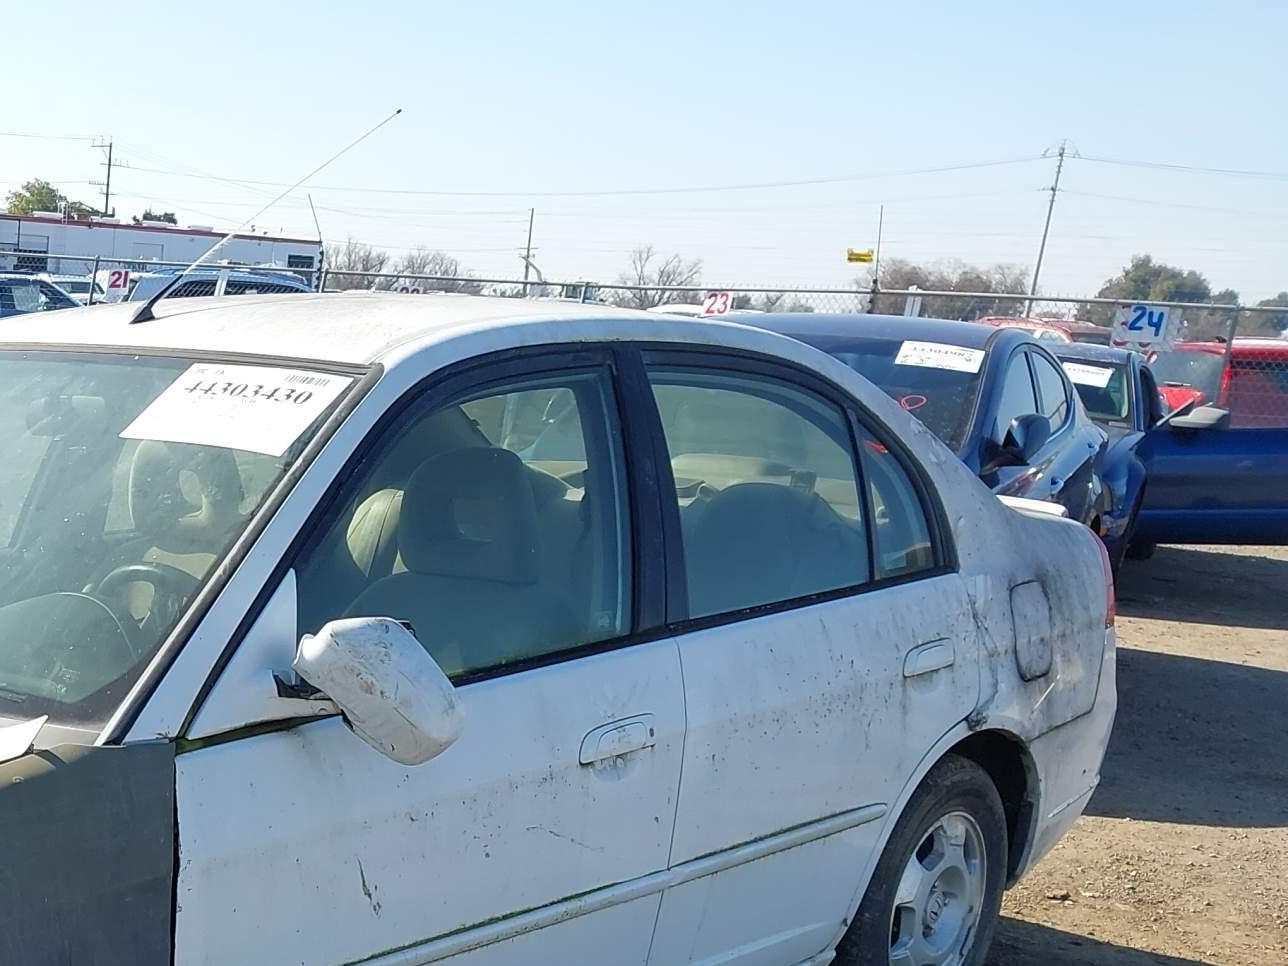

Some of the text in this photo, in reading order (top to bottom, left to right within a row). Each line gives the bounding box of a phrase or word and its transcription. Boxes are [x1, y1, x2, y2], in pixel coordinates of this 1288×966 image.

[108, 270, 129, 289] 21
[704, 293, 730, 315] 23
[1127, 305, 1165, 337] 24
[183, 380, 314, 405] 44303430
